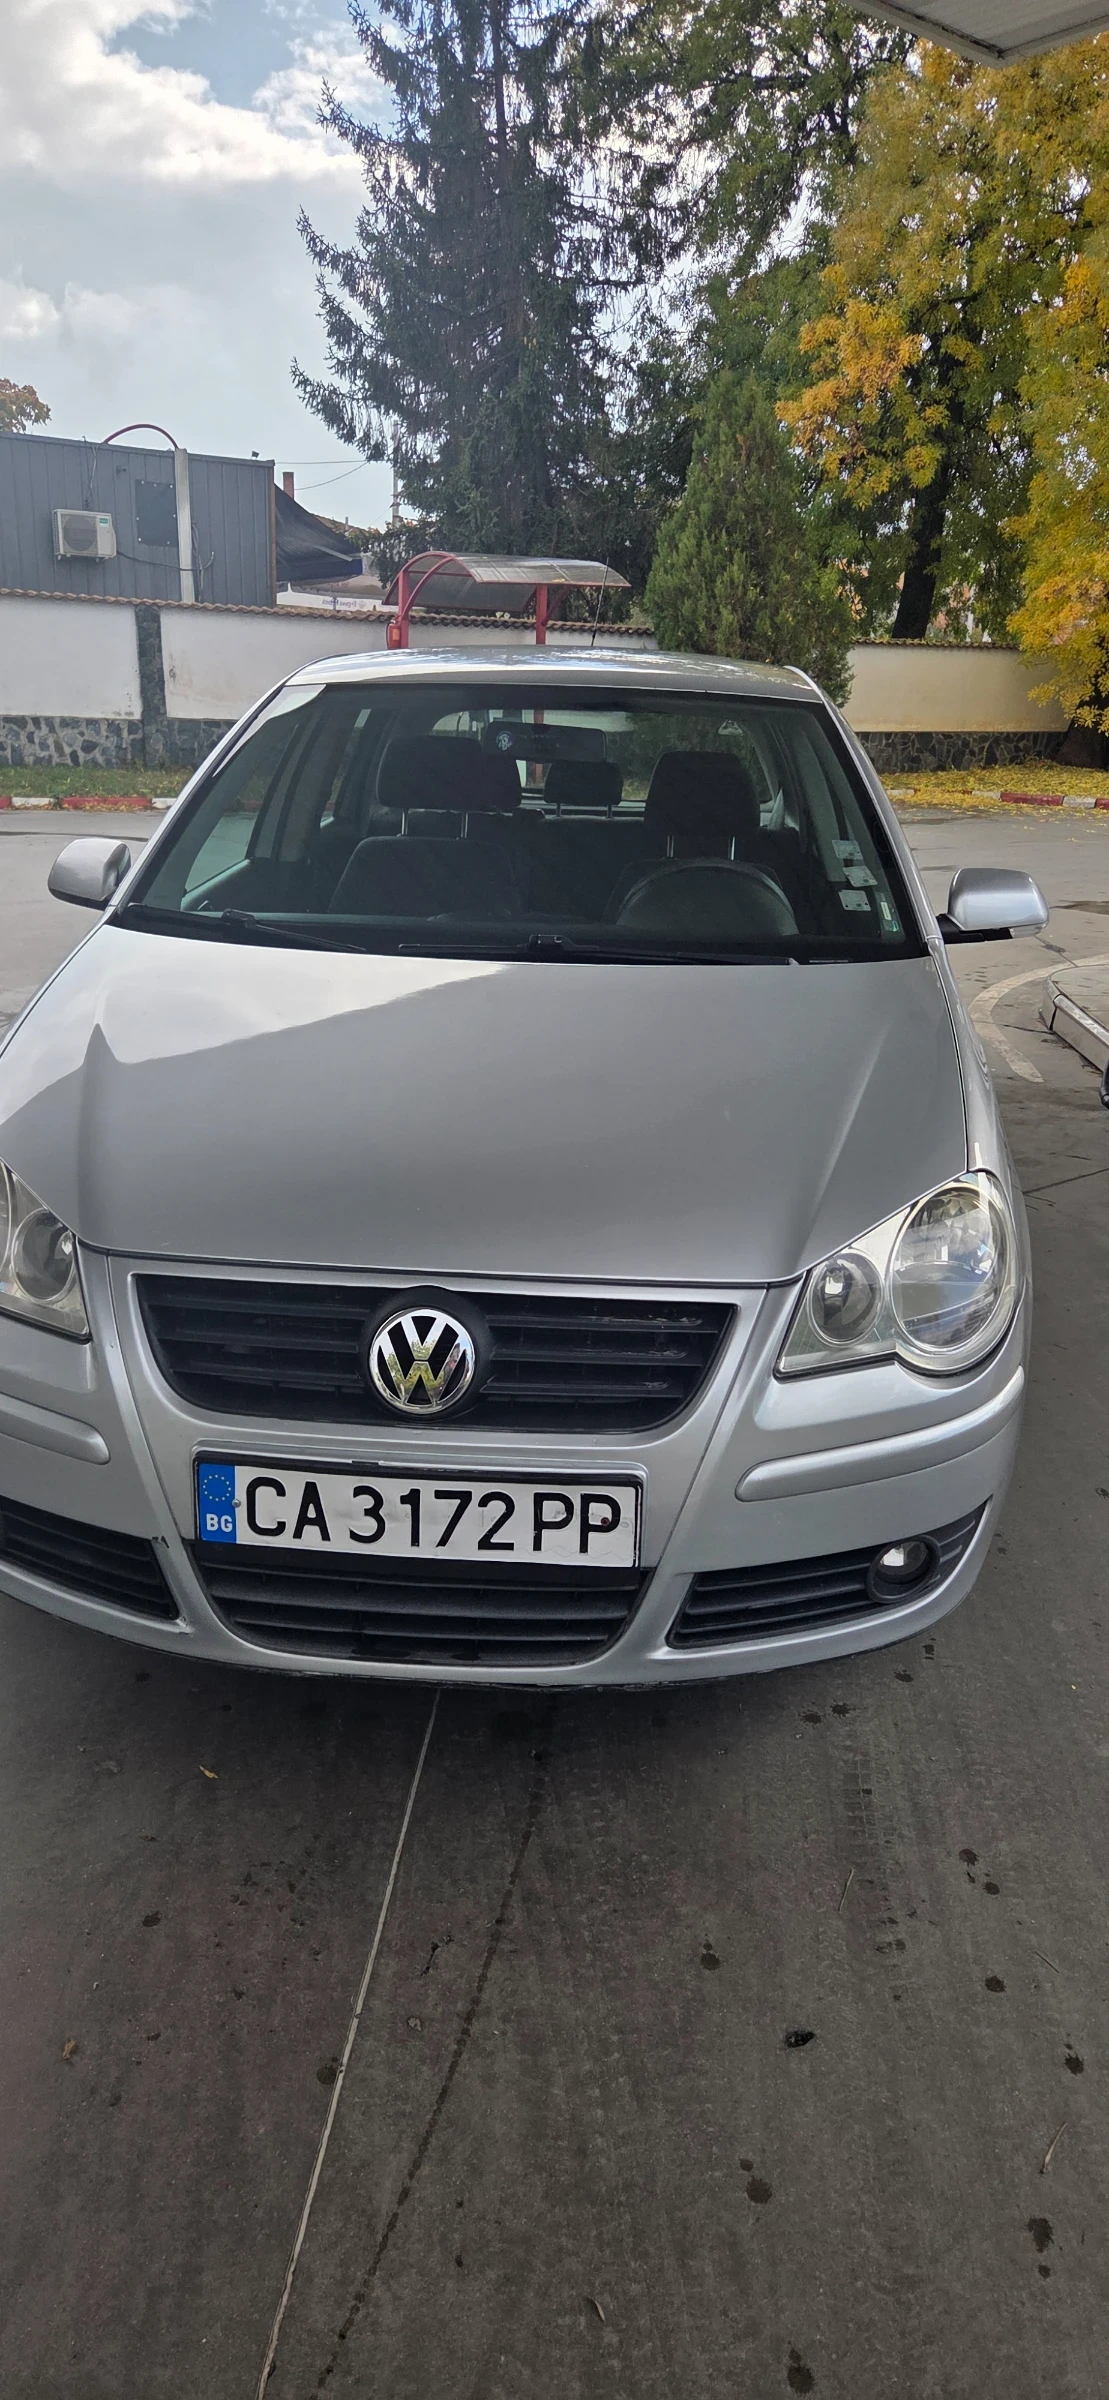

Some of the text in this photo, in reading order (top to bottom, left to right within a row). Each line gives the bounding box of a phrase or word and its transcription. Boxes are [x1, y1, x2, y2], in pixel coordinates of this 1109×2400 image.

[371, 1308, 475, 1413] VW
[205, 1513, 233, 1533] BG
[246, 1476, 621, 1554] CA 3172 PP
